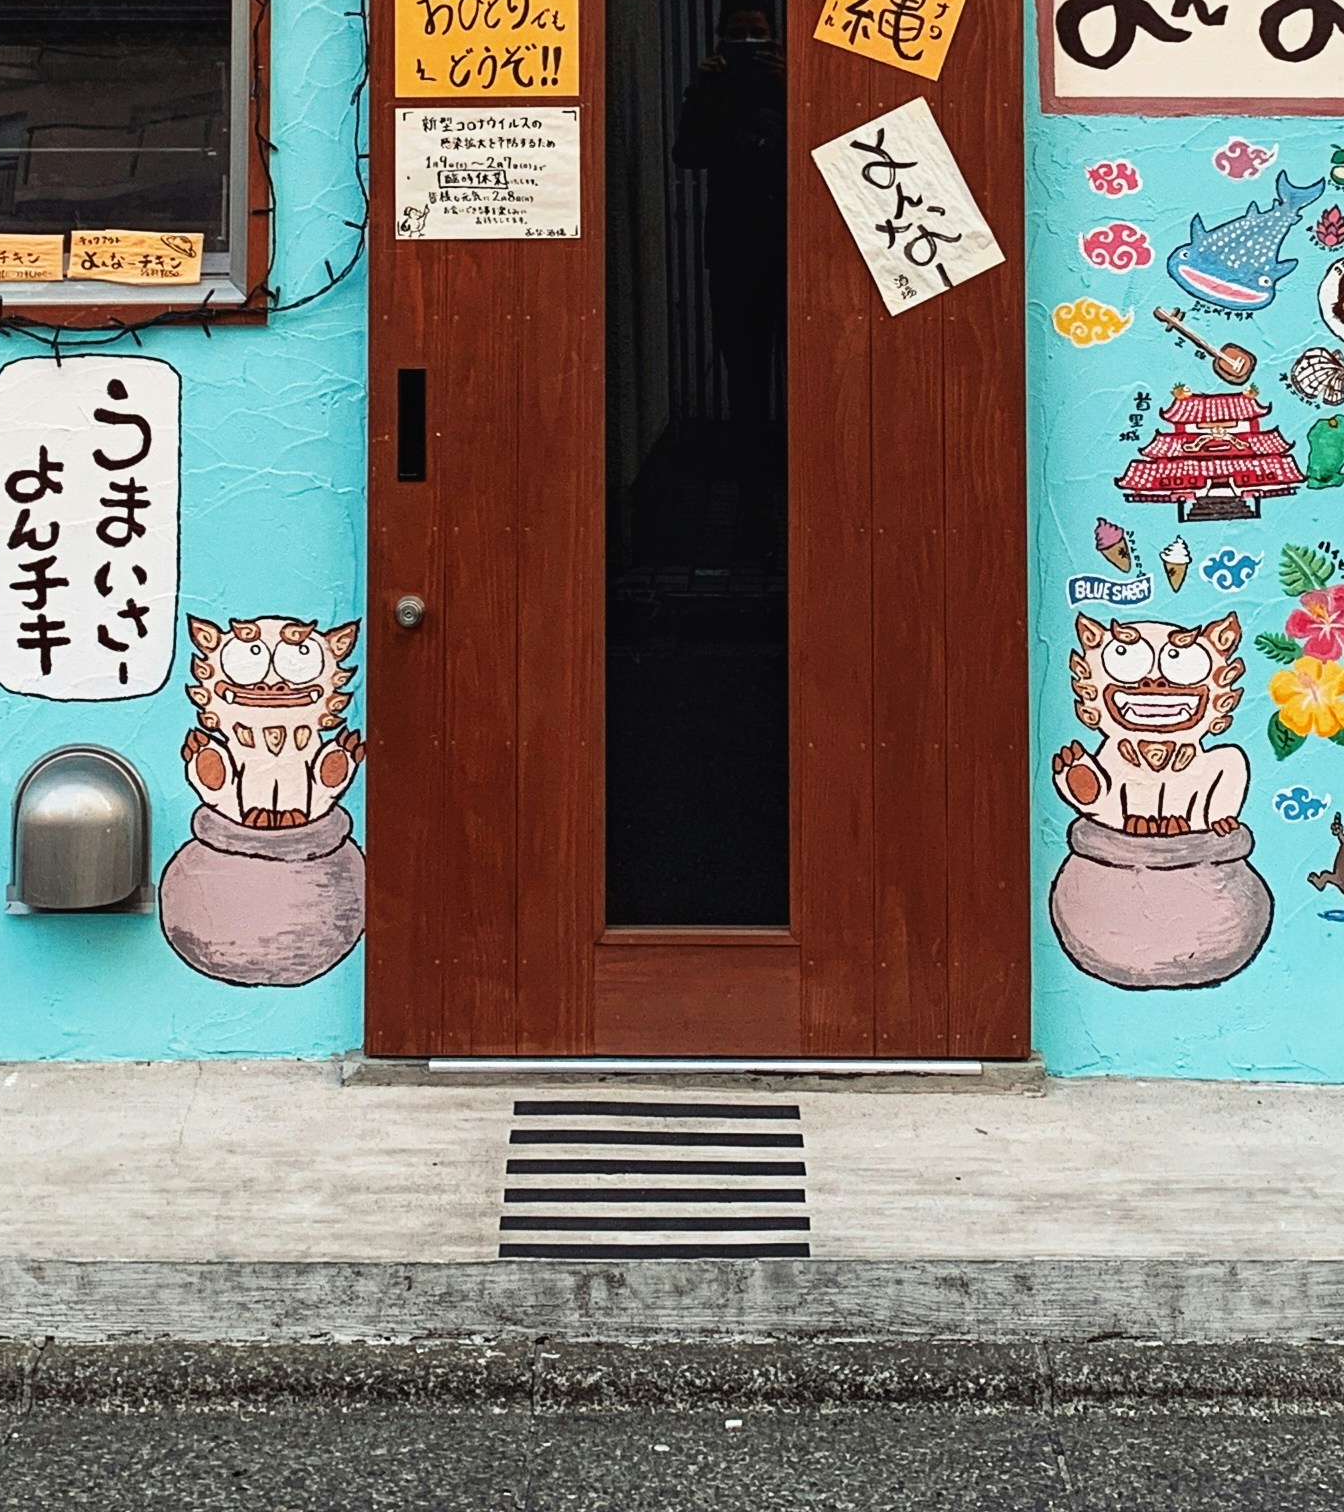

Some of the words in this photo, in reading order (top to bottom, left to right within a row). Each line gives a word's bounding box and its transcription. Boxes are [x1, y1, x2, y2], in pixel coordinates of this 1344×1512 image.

[422, 117, 543, 133] 新型コロナウイルスの
[92, 378, 153, 685] うまいさー
[1074, 580, 1111, 599] BLUE
